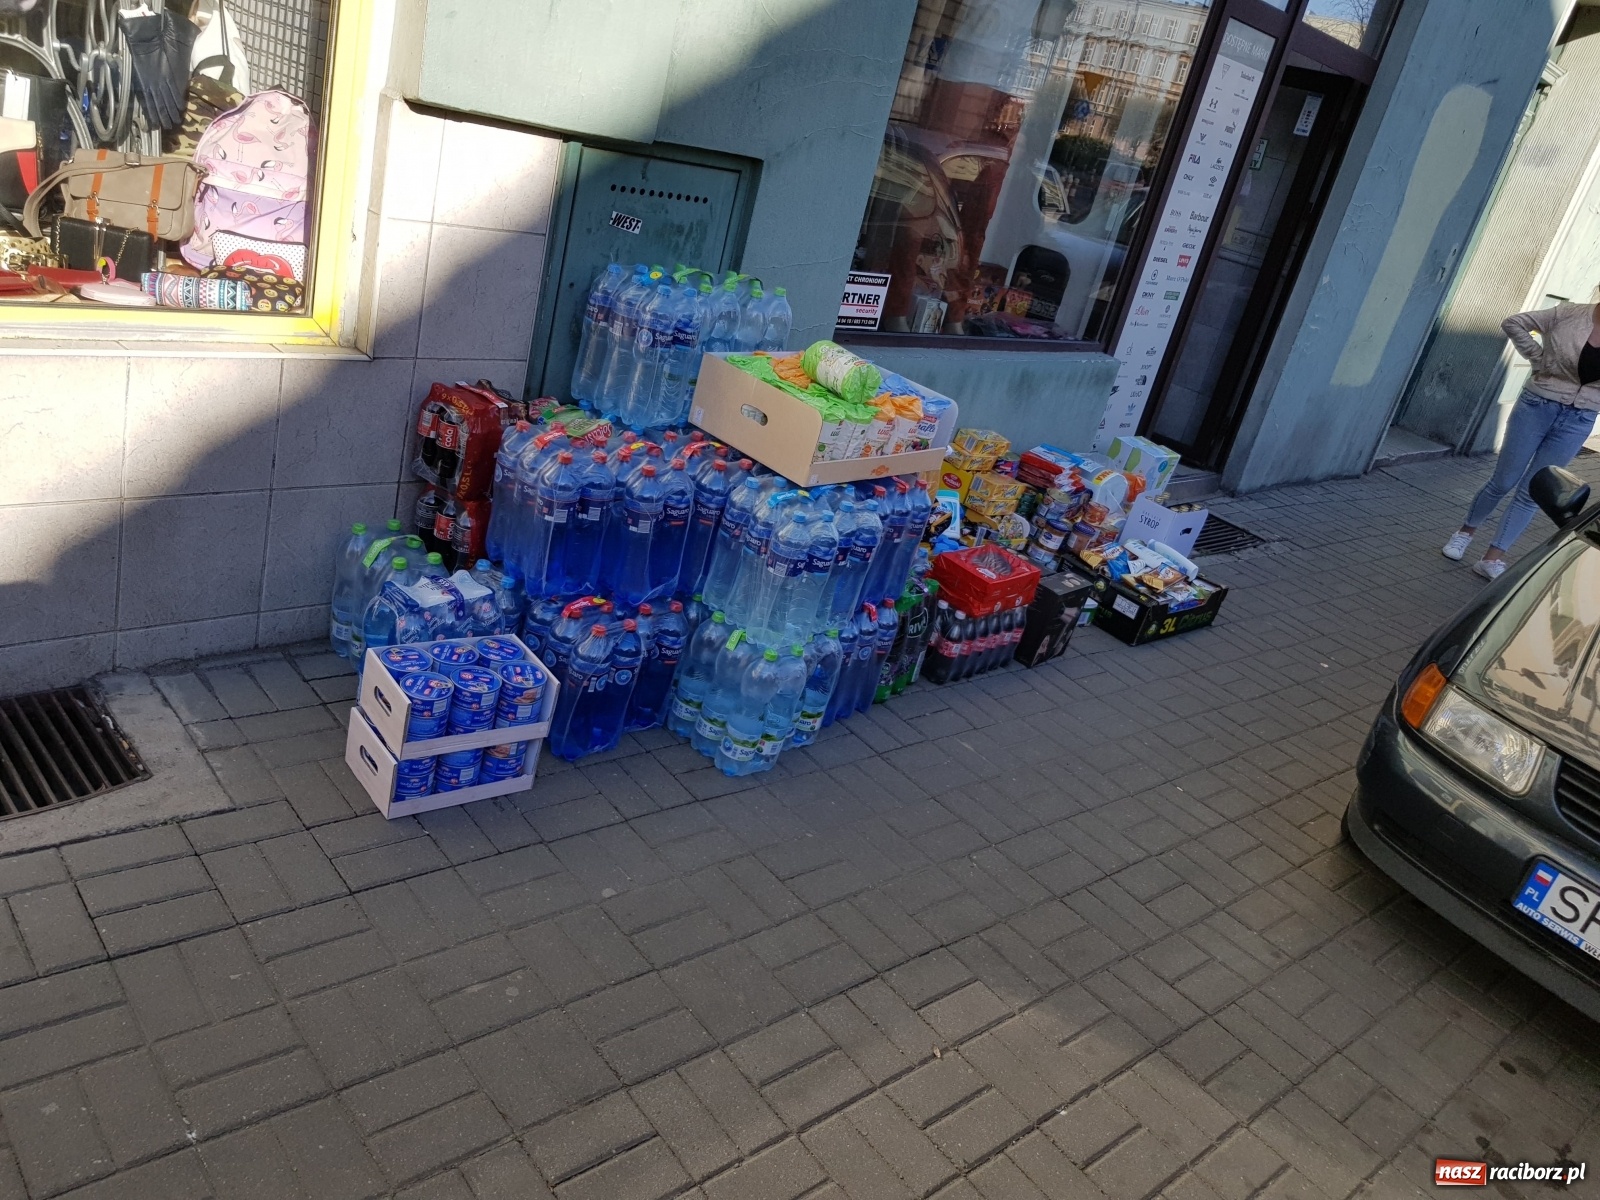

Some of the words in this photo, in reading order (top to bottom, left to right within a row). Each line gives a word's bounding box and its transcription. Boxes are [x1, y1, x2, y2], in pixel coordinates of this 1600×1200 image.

[1188, 154, 1201, 164] FILA
[1190, 210, 1209, 222] Barbour
[612, 213, 641, 232] WEST
[1182, 242, 1196, 250] GEOX
[1153, 256, 1168, 264] DIESEL
[842, 292, 881, 305] RTNER
[1142, 291, 1155, 299] DKNY
[444, 428, 454, 447] cola
[666, 507, 690, 516] Saguaro
[696, 504, 721, 516] Saguaro
[1139, 514, 1160, 530] SYROP
[1160, 617, 1177, 634] 3L
[1524, 886, 1539, 902] PL
[1516, 902, 1541, 920] AUTO
[1541, 916, 1580, 945] SERWIS
